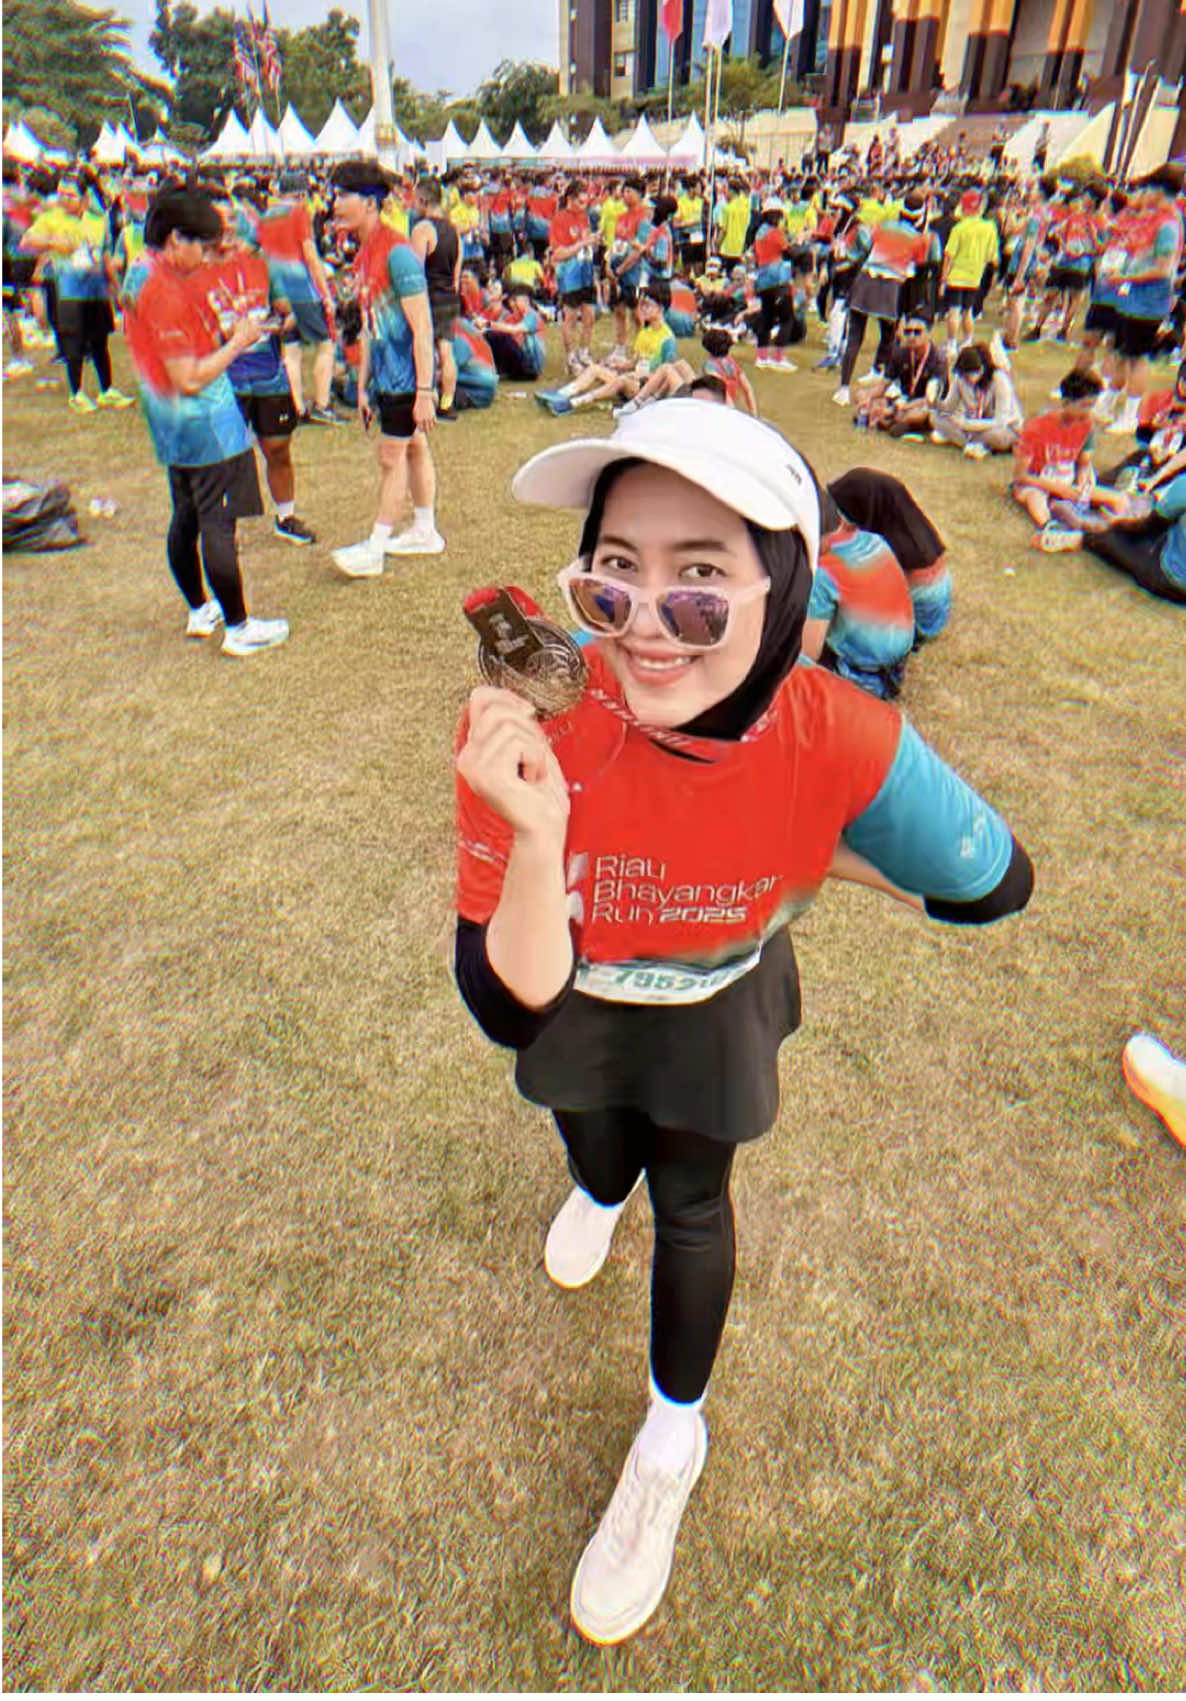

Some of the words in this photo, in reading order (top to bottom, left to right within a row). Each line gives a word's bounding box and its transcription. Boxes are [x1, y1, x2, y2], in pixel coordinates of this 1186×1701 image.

[594, 854, 666, 881] Riau
[591, 902, 654, 925] Run
[659, 906, 748, 924] 2025
